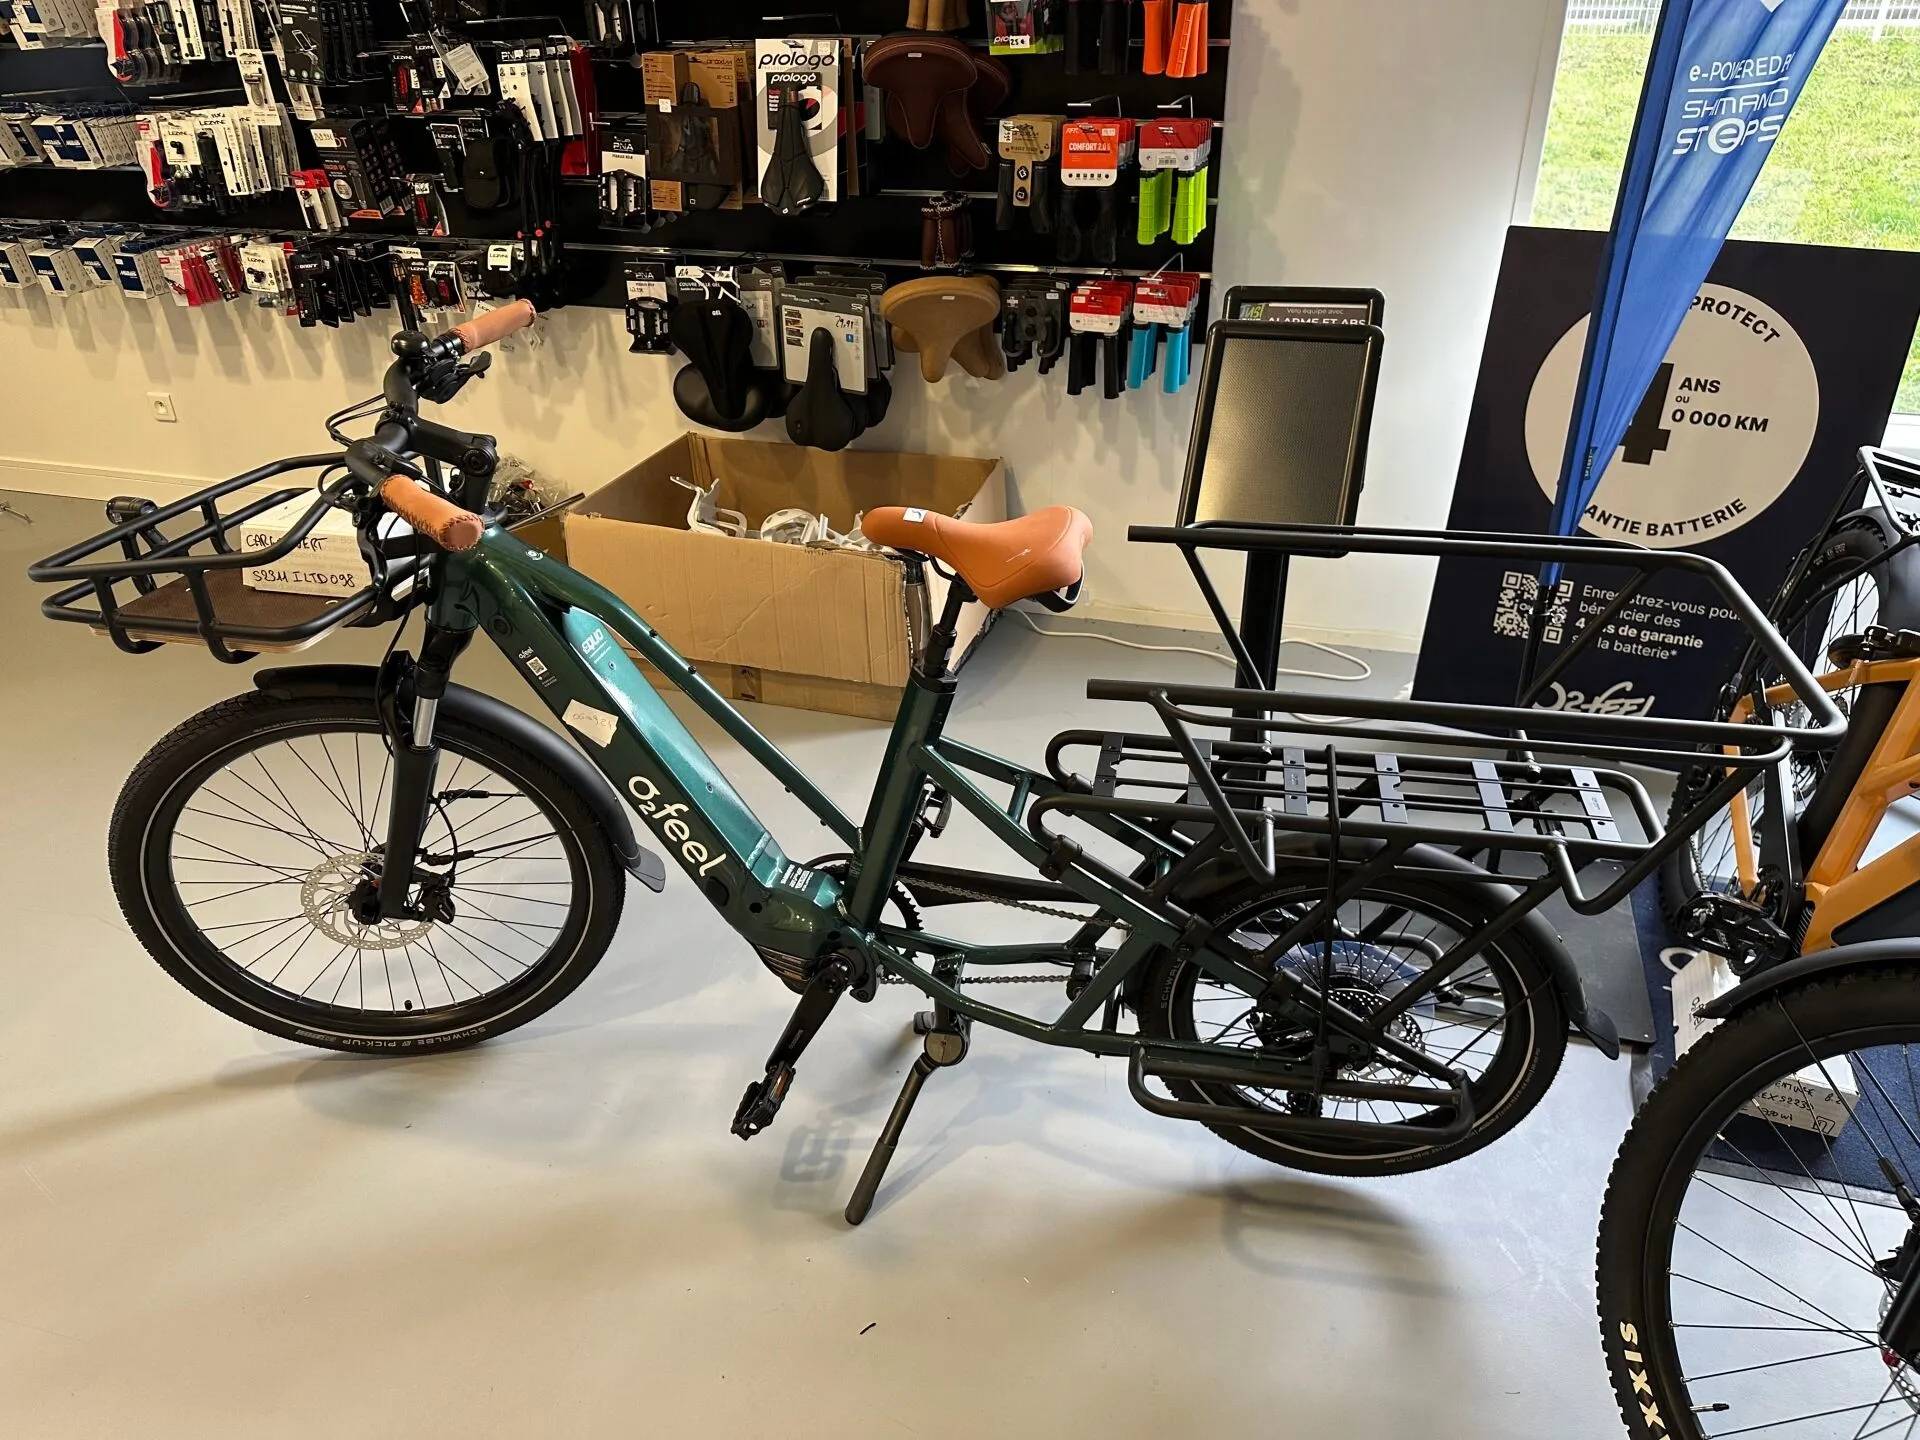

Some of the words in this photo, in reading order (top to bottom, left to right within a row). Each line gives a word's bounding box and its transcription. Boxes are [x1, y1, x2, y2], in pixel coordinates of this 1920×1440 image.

[758, 52, 835, 70] prologo
[771, 73, 817, 84] prologo
[1682, 88, 1789, 119] SHIMANO
[1689, 295, 1781, 343] PROTECT
[1678, 377, 1721, 394] ANS
[1689, 410, 1731, 429] 000
[1734, 415, 1769, 433] KM
[1584, 504, 1642, 535] ANTIE
[1645, 498, 1748, 537] BATTERIE
[1582, 584, 1706, 617] Enretrez-vous
[1708, 606, 1742, 622] pou
[1653, 613, 1681, 629] des
[1597, 637, 1610, 650] la
[1618, 624, 1637, 638] de
[1639, 629, 1704, 649] garantie
